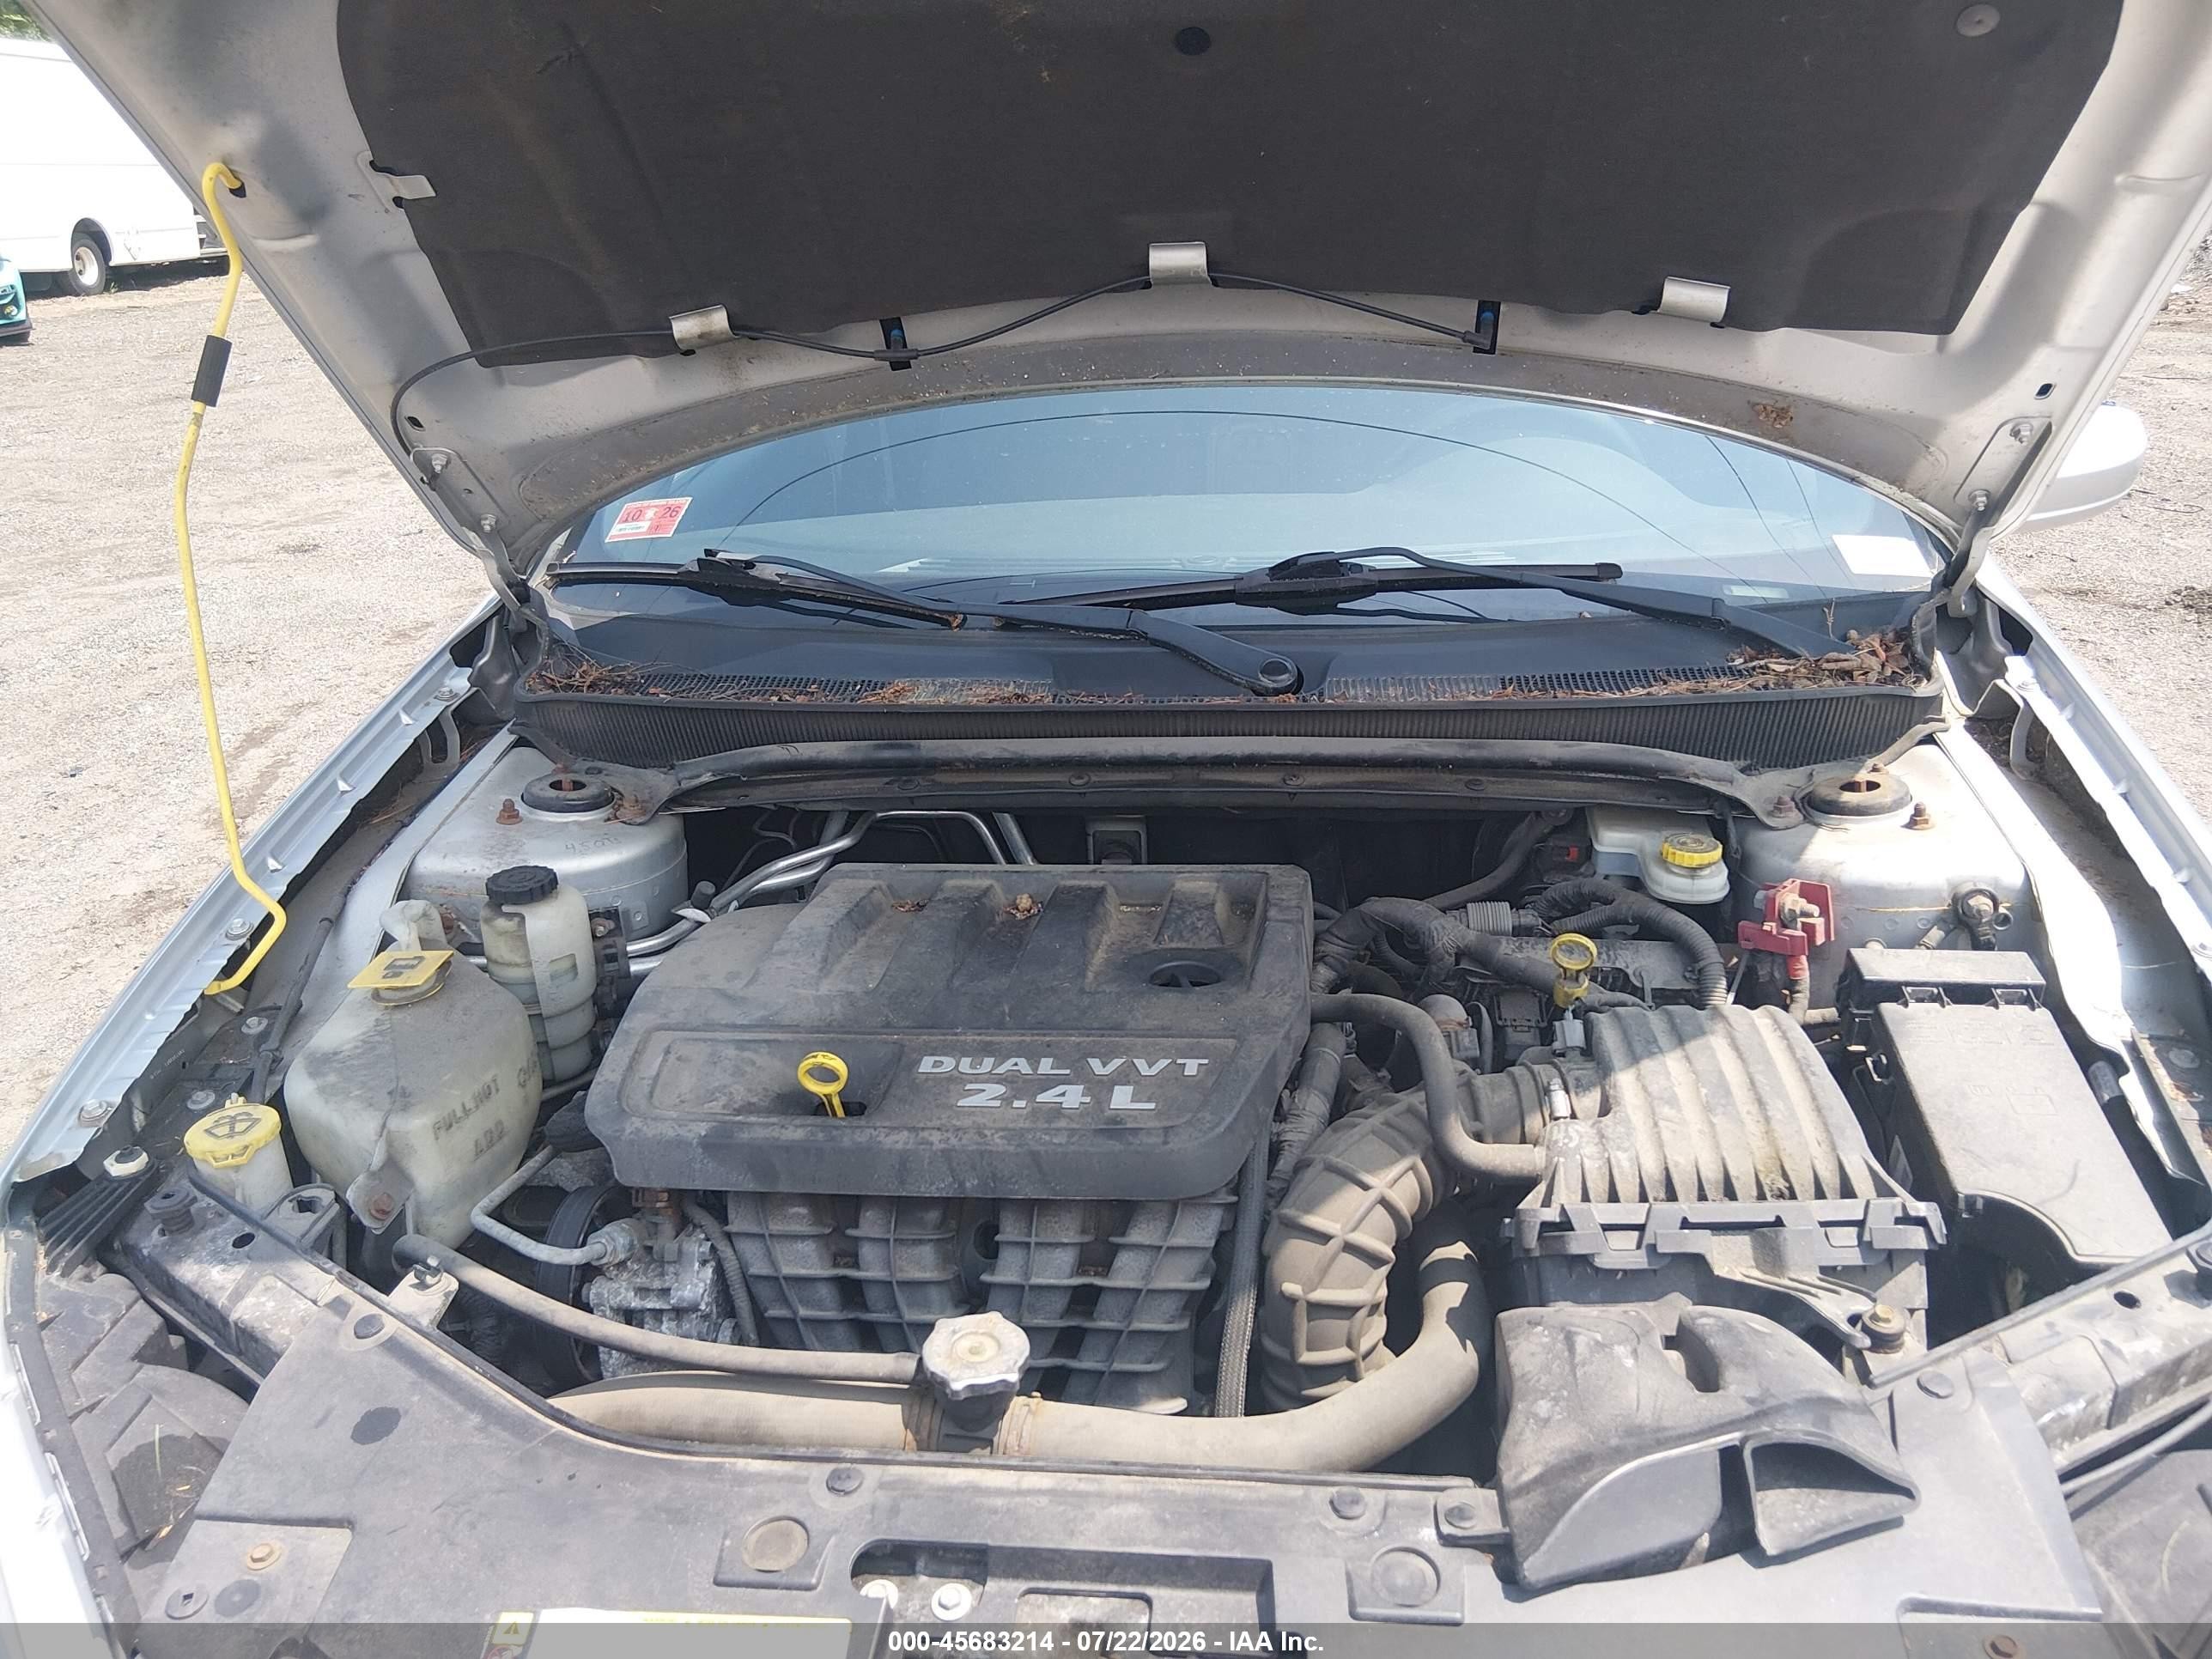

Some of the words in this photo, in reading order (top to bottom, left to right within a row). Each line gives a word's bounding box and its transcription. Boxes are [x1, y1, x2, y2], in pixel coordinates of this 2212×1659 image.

[623, 508, 642, 522] 10
[659, 506, 681, 520] 26
[917, 1055, 1072, 1076] DUAL
[1086, 1057, 1210, 1077] VVT
